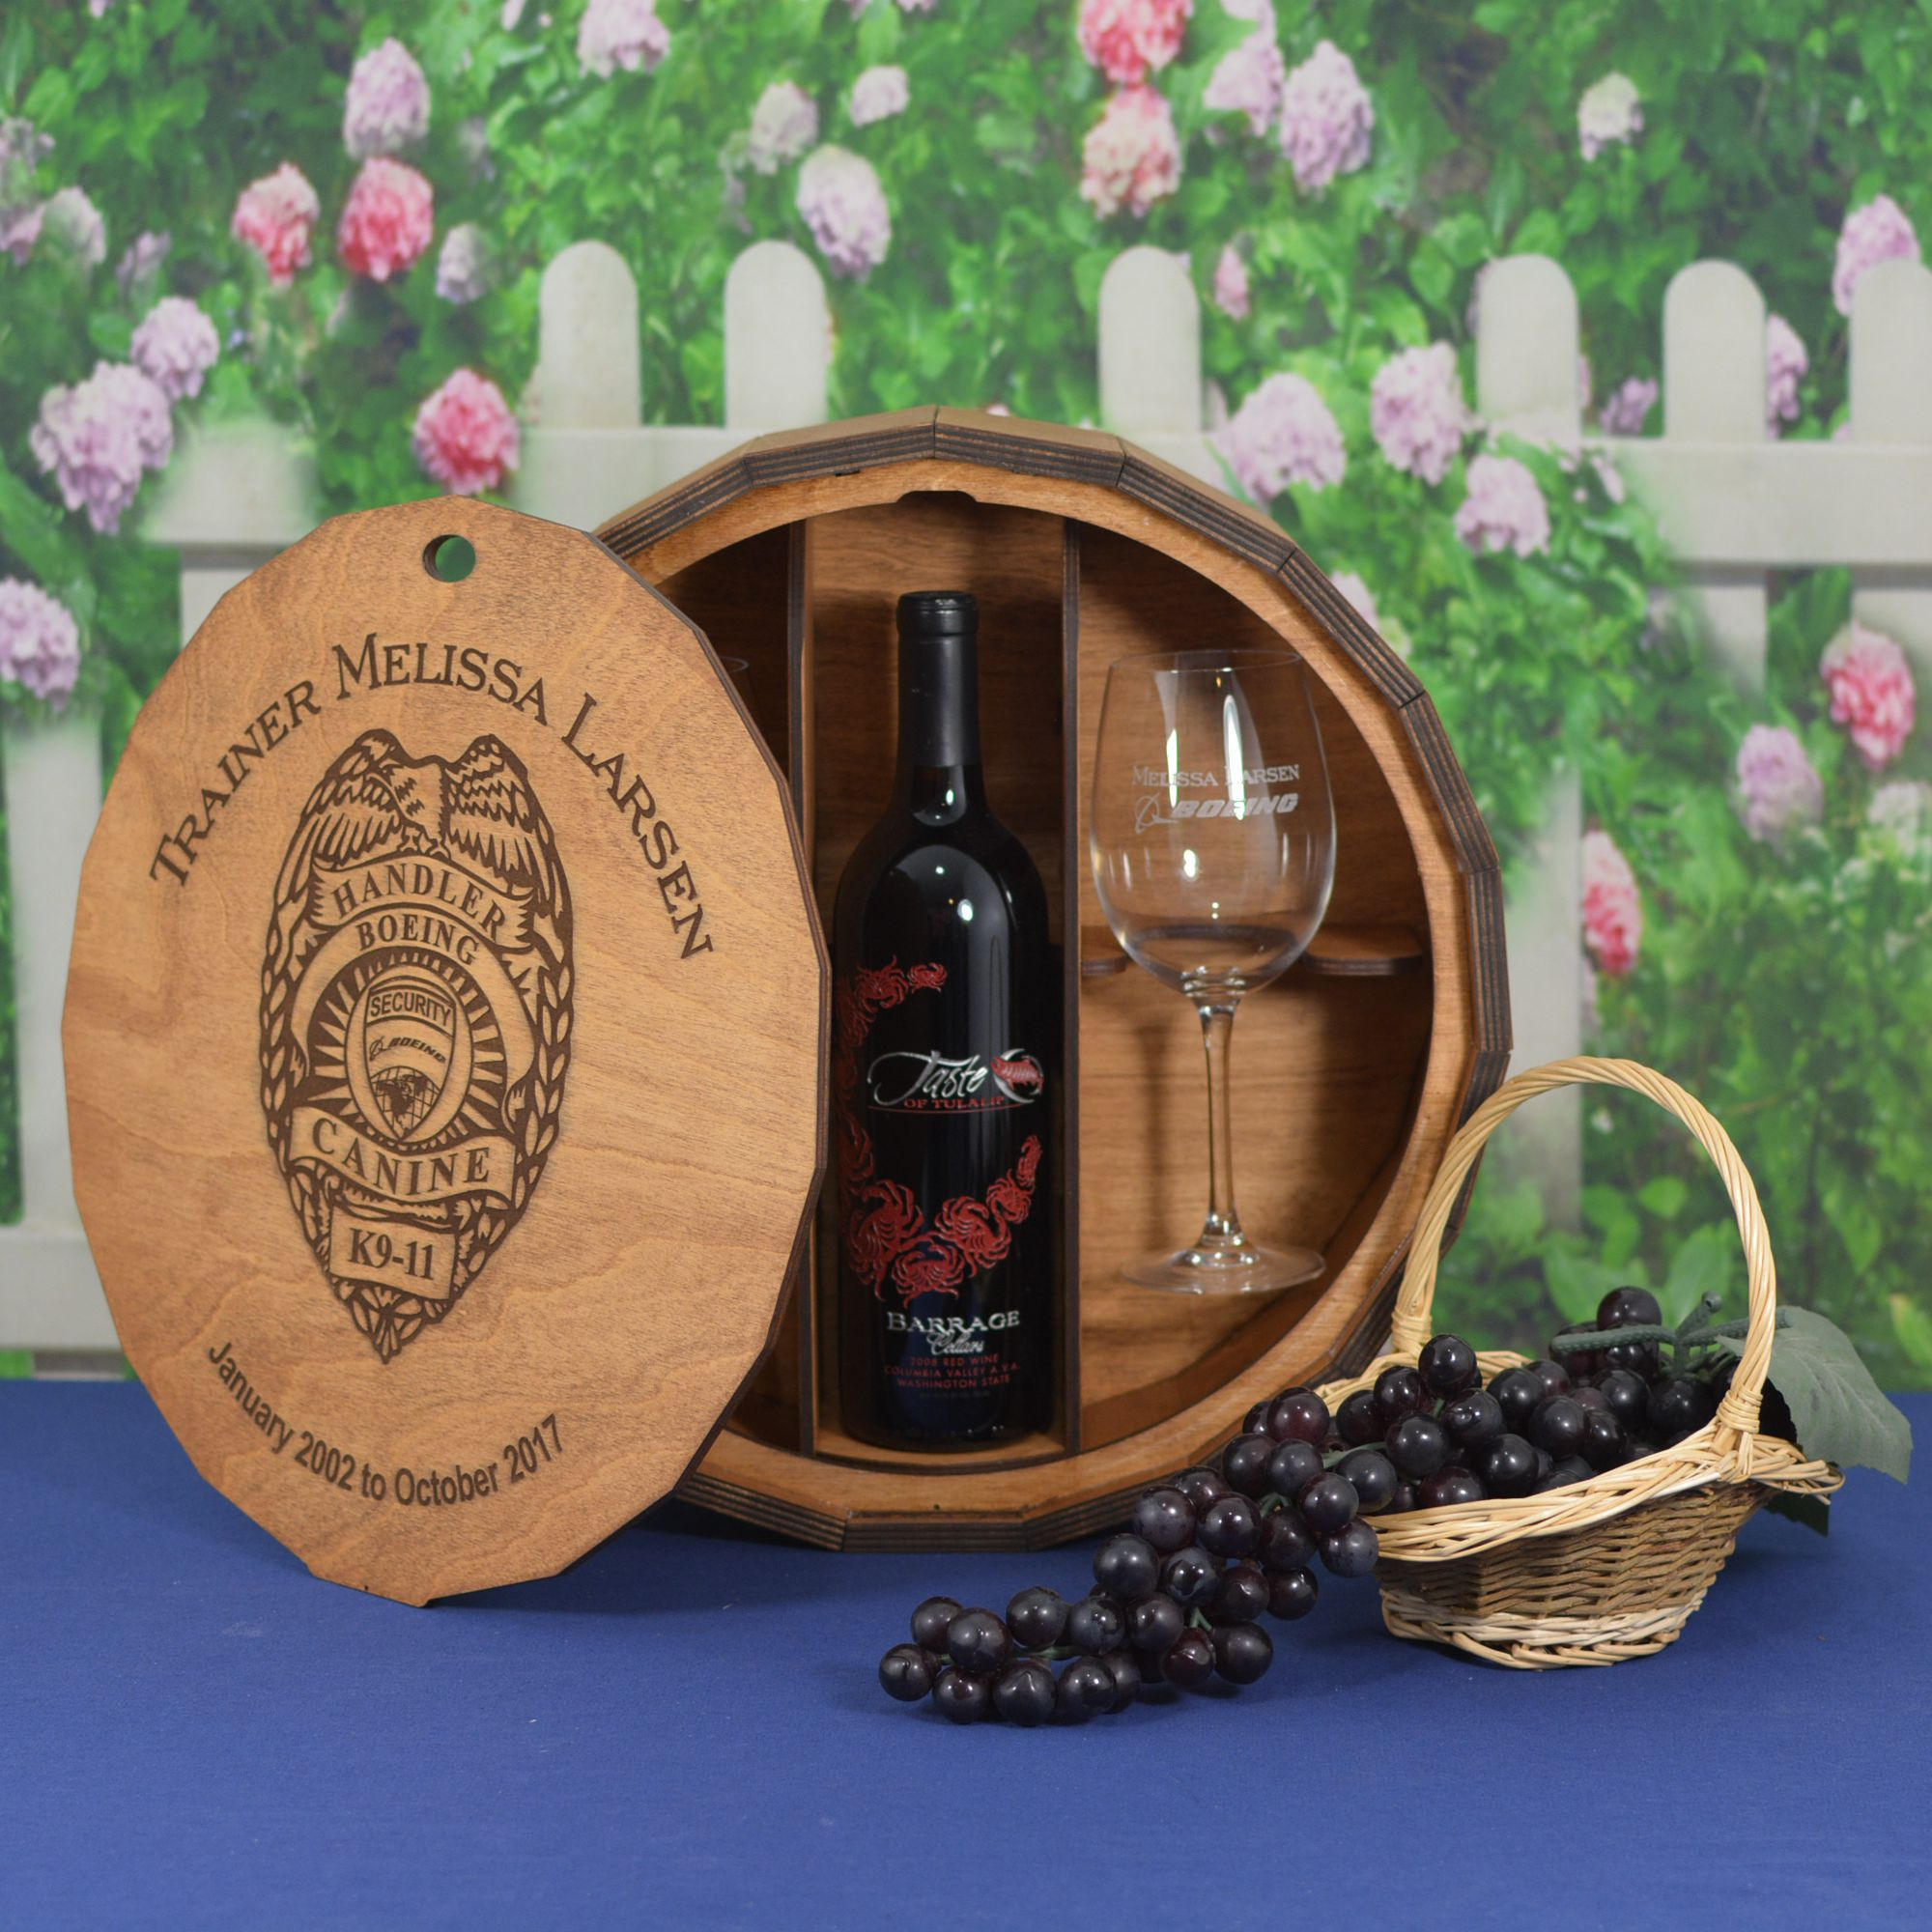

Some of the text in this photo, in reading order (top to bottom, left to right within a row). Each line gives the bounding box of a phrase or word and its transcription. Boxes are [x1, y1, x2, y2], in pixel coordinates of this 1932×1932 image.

[149, 632, 714, 959] TRAINER MELISSA LARSEN
[1170, 792, 1299, 819] BOEING
[331, 863, 506, 941] HANDLER
[355, 913, 480, 965] BOEING
[370, 992, 452, 1026] SECURITY
[388, 1037, 446, 1063] BOEING
[867, 1050, 988, 1105] Taste
[903, 1098, 927, 1108] OF
[312, 1118, 490, 1195] CANINE
[348, 1228, 434, 1281] K9-11
[887, 1311, 1020, 1332] BARRAGE
[884, 1365, 942, 1378] COLUMBIA
[947, 1367, 986, 1378] VALLEY
[943, 1357, 964, 1366] RED
[970, 1353, 999, 1365] WINE
[896, 1374, 1010, 1389] WASHINGTON STATE
[208, 1342, 564, 1506] January 2002 to October 2017
